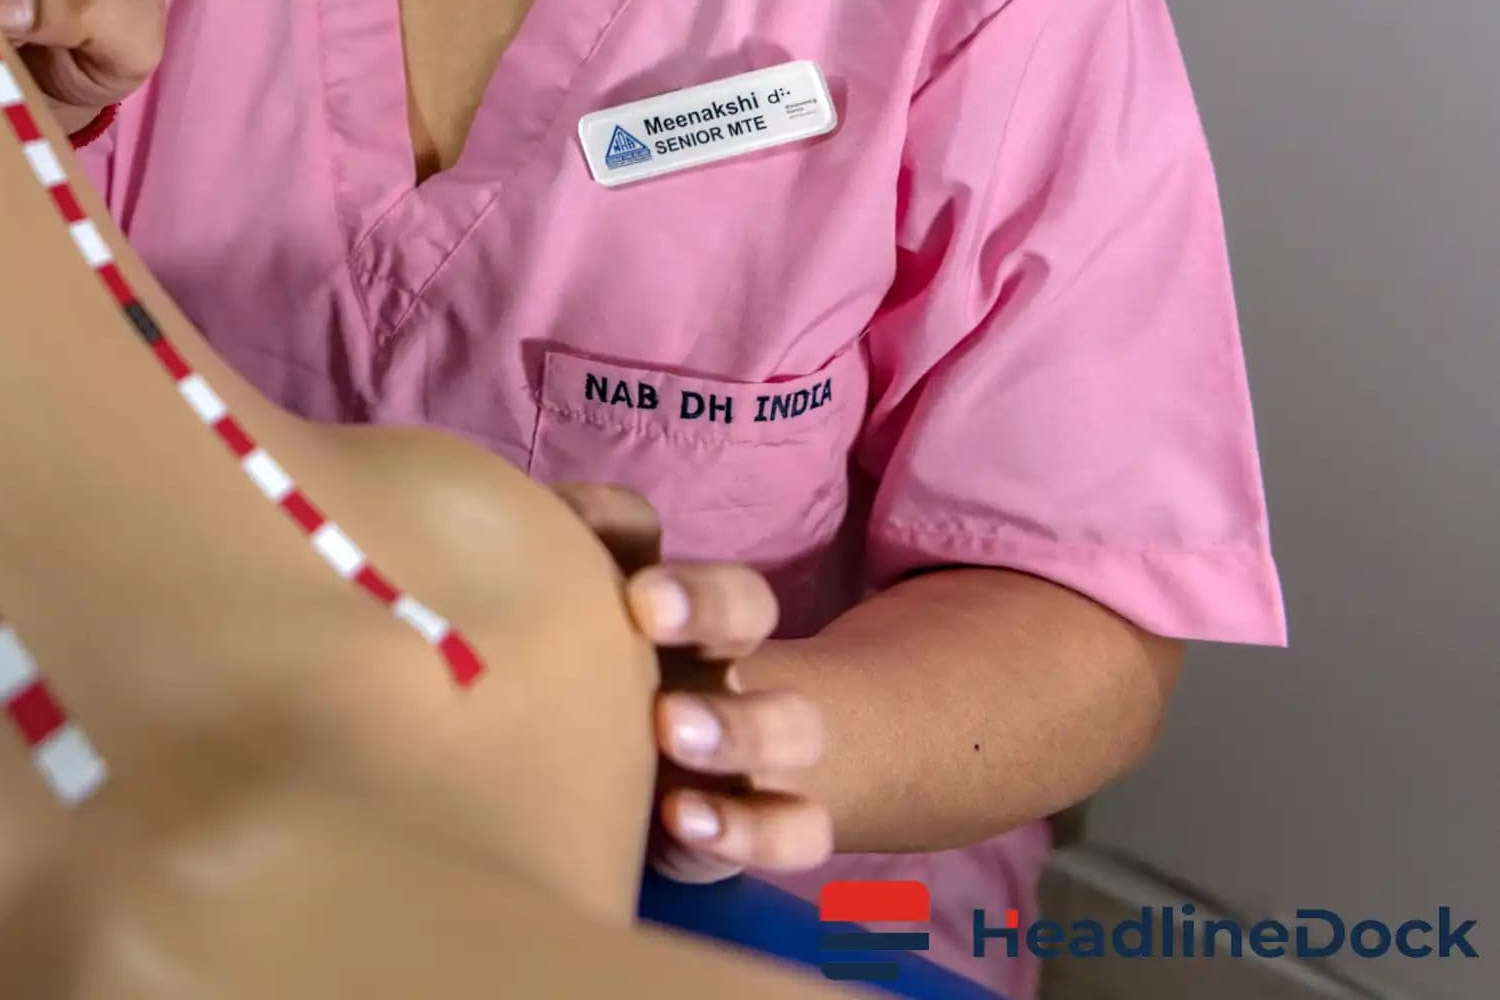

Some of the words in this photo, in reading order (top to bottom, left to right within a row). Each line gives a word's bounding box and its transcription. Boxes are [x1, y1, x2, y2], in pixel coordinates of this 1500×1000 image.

[643, 92, 759, 135] Meenakshi
[655, 127, 723, 155] SENIOR
[727, 115, 767, 141] MTE
[585, 373, 659, 410] NAB
[680, 390, 733, 423] DH
[754, 378, 833, 422] INDIA
